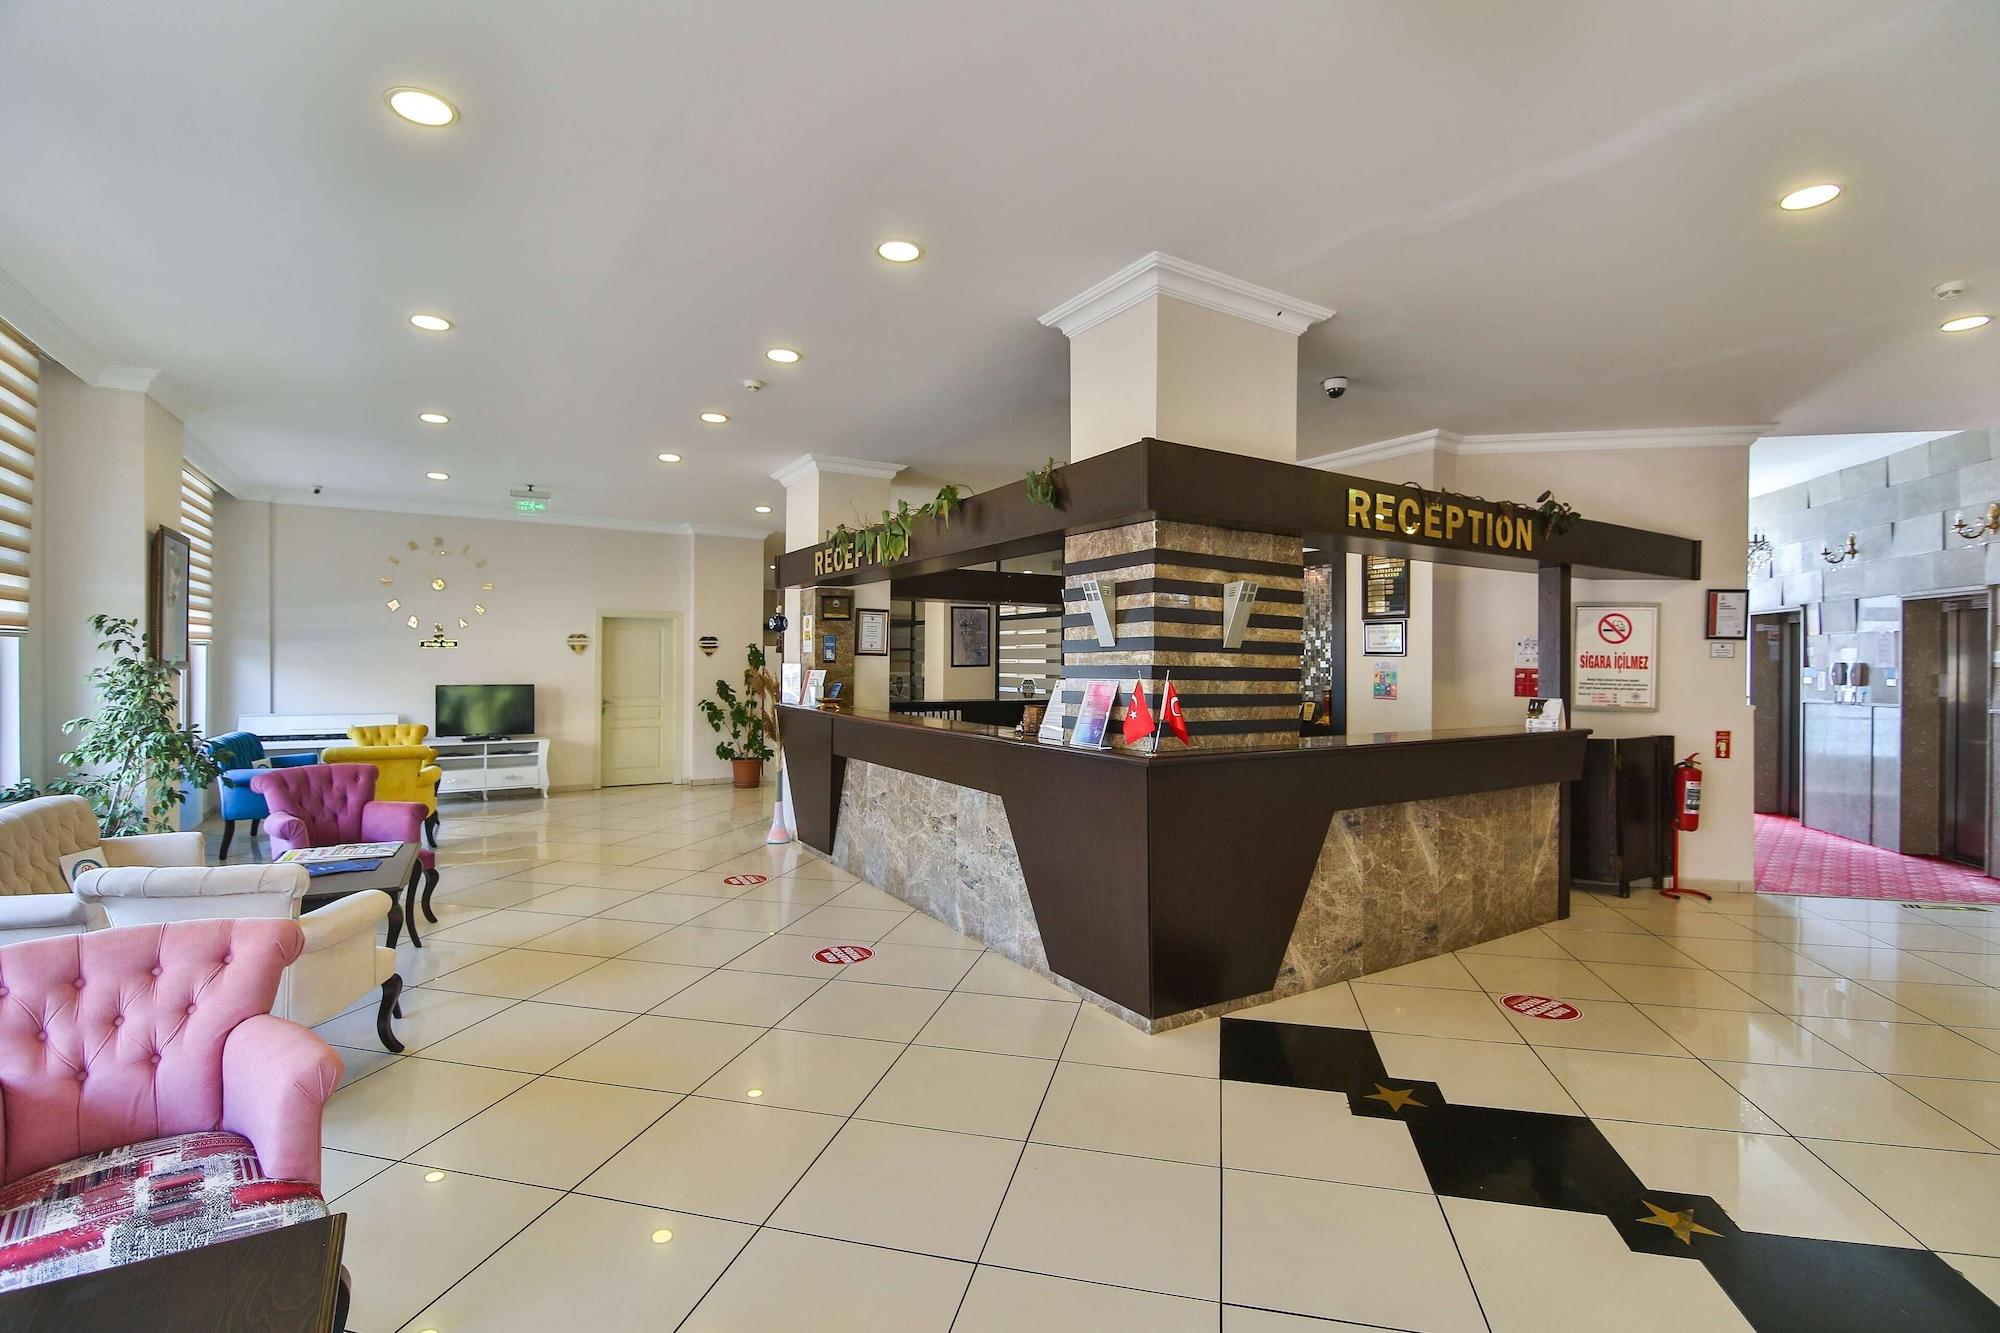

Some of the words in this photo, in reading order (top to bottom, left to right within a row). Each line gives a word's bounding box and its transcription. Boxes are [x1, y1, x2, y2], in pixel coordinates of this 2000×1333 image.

[1348, 488, 1533, 551] RECEPTION
[1580, 651, 1612, 669] SİGARA
[1614, 651, 1649, 673] İÇİLMEZ
